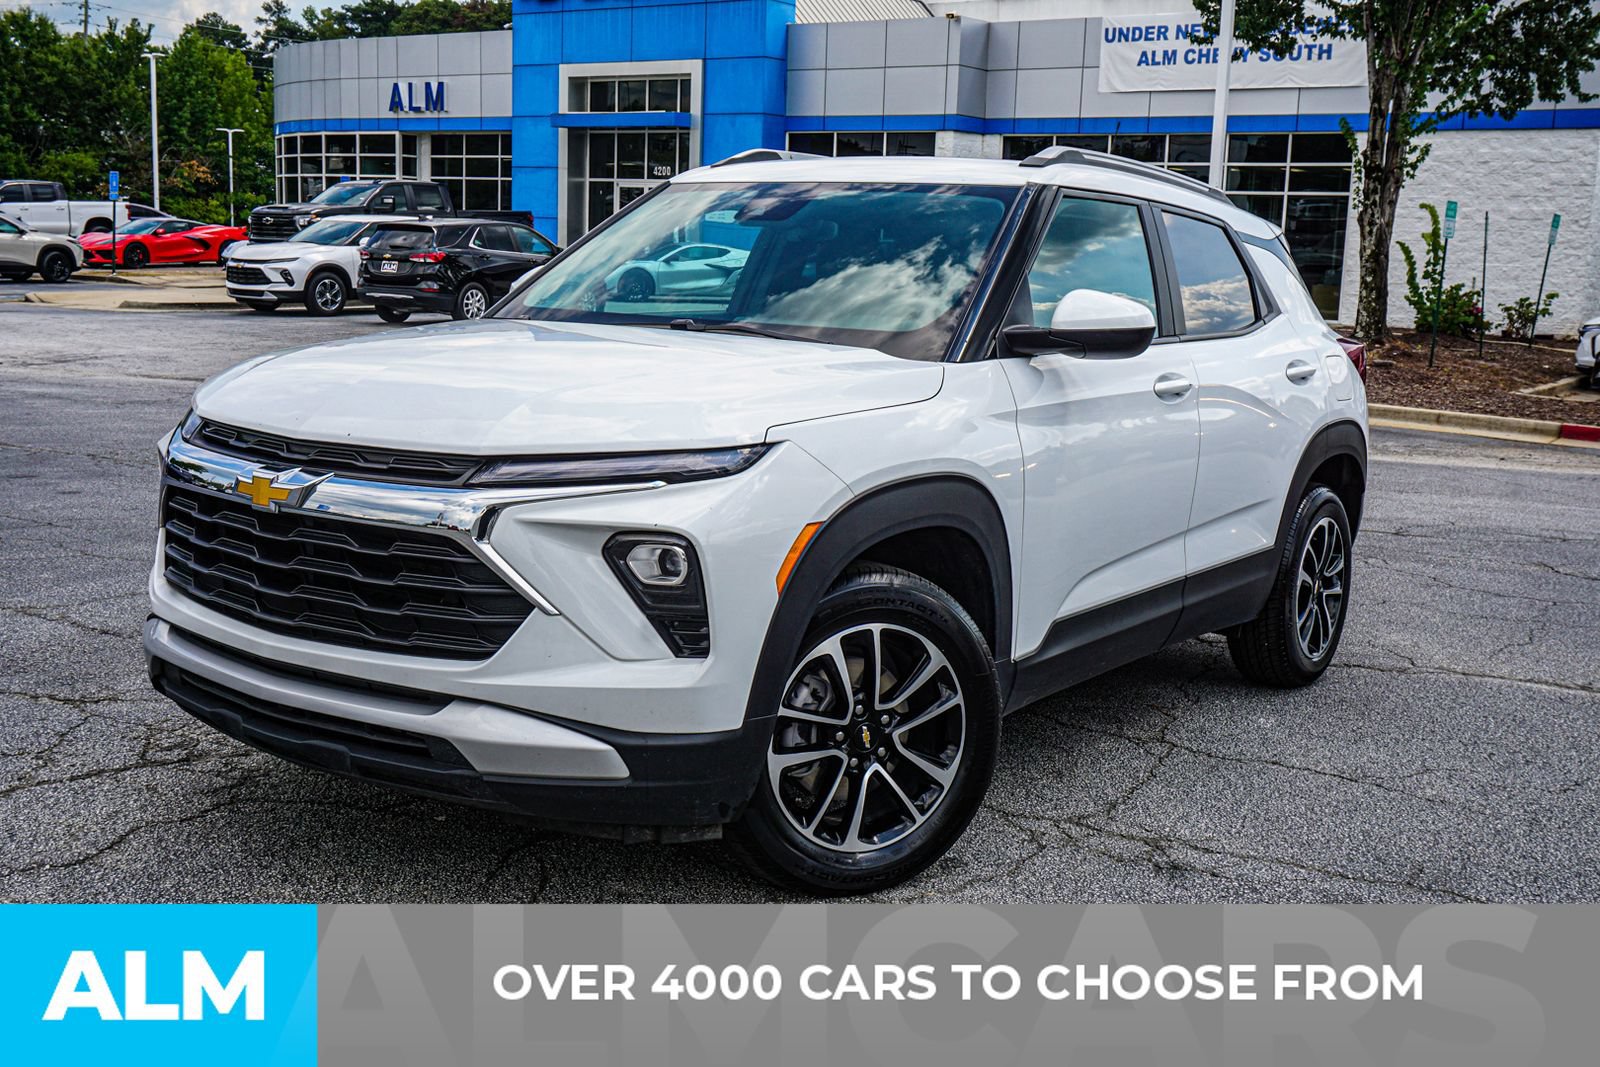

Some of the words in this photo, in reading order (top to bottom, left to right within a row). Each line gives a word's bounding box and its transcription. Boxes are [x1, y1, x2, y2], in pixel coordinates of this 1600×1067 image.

[1104, 25, 1169, 43] UNDER
[1137, 50, 1177, 67] ALM
[389, 82, 446, 112] ALM
[653, 166, 671, 176] 4200
